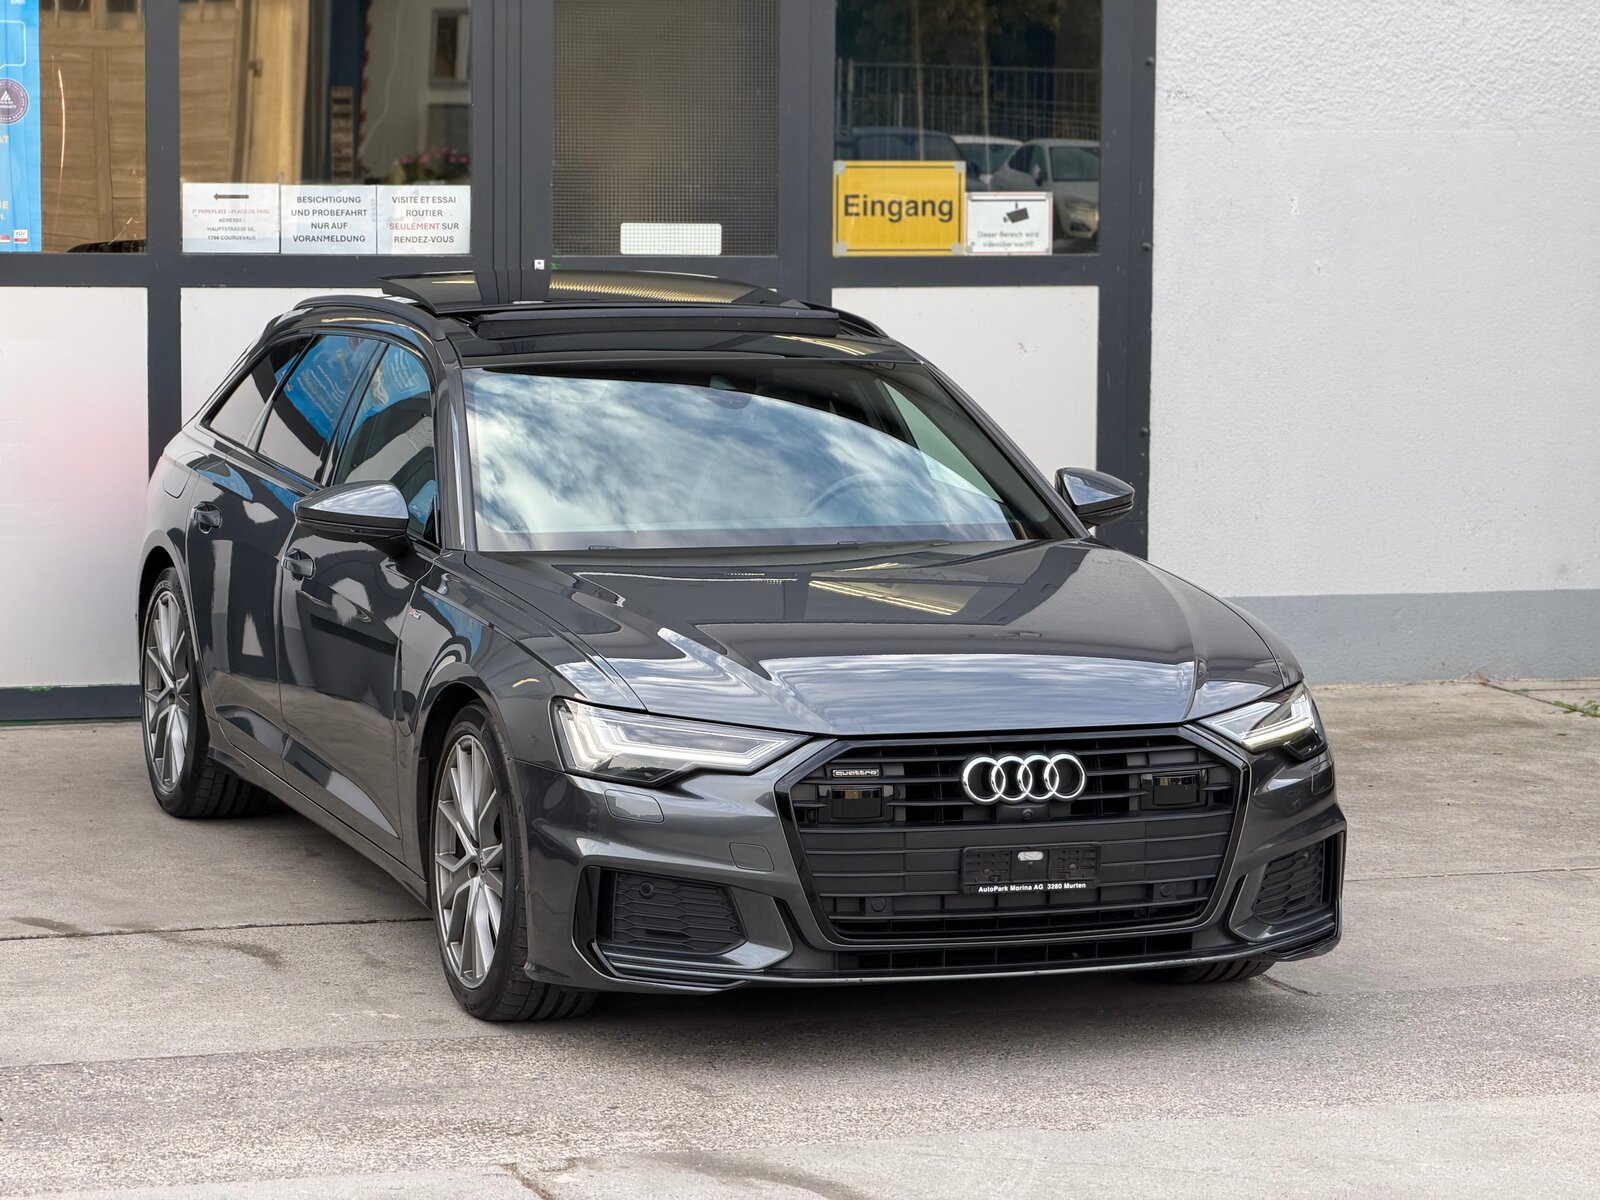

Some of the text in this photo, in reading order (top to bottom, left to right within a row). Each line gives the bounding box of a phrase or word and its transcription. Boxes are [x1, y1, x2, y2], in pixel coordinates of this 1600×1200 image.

[296, 196, 362, 204] BESICHTIGUNG
[392, 196, 457, 204] VISITE ET ESSAI
[844, 194, 953, 223] Eingang
[291, 209, 368, 217] UND PROBEFAHRT
[405, 209, 443, 217] ROUTIER
[311, 222, 348, 230] NUR AUF
[389, 222, 460, 230] SEULEMENT SUR
[292, 235, 366, 243] VORANMELDUNG
[394, 235, 455, 243] RENDEZ-VOUS
[978, 885, 1009, 893] AutoPark
